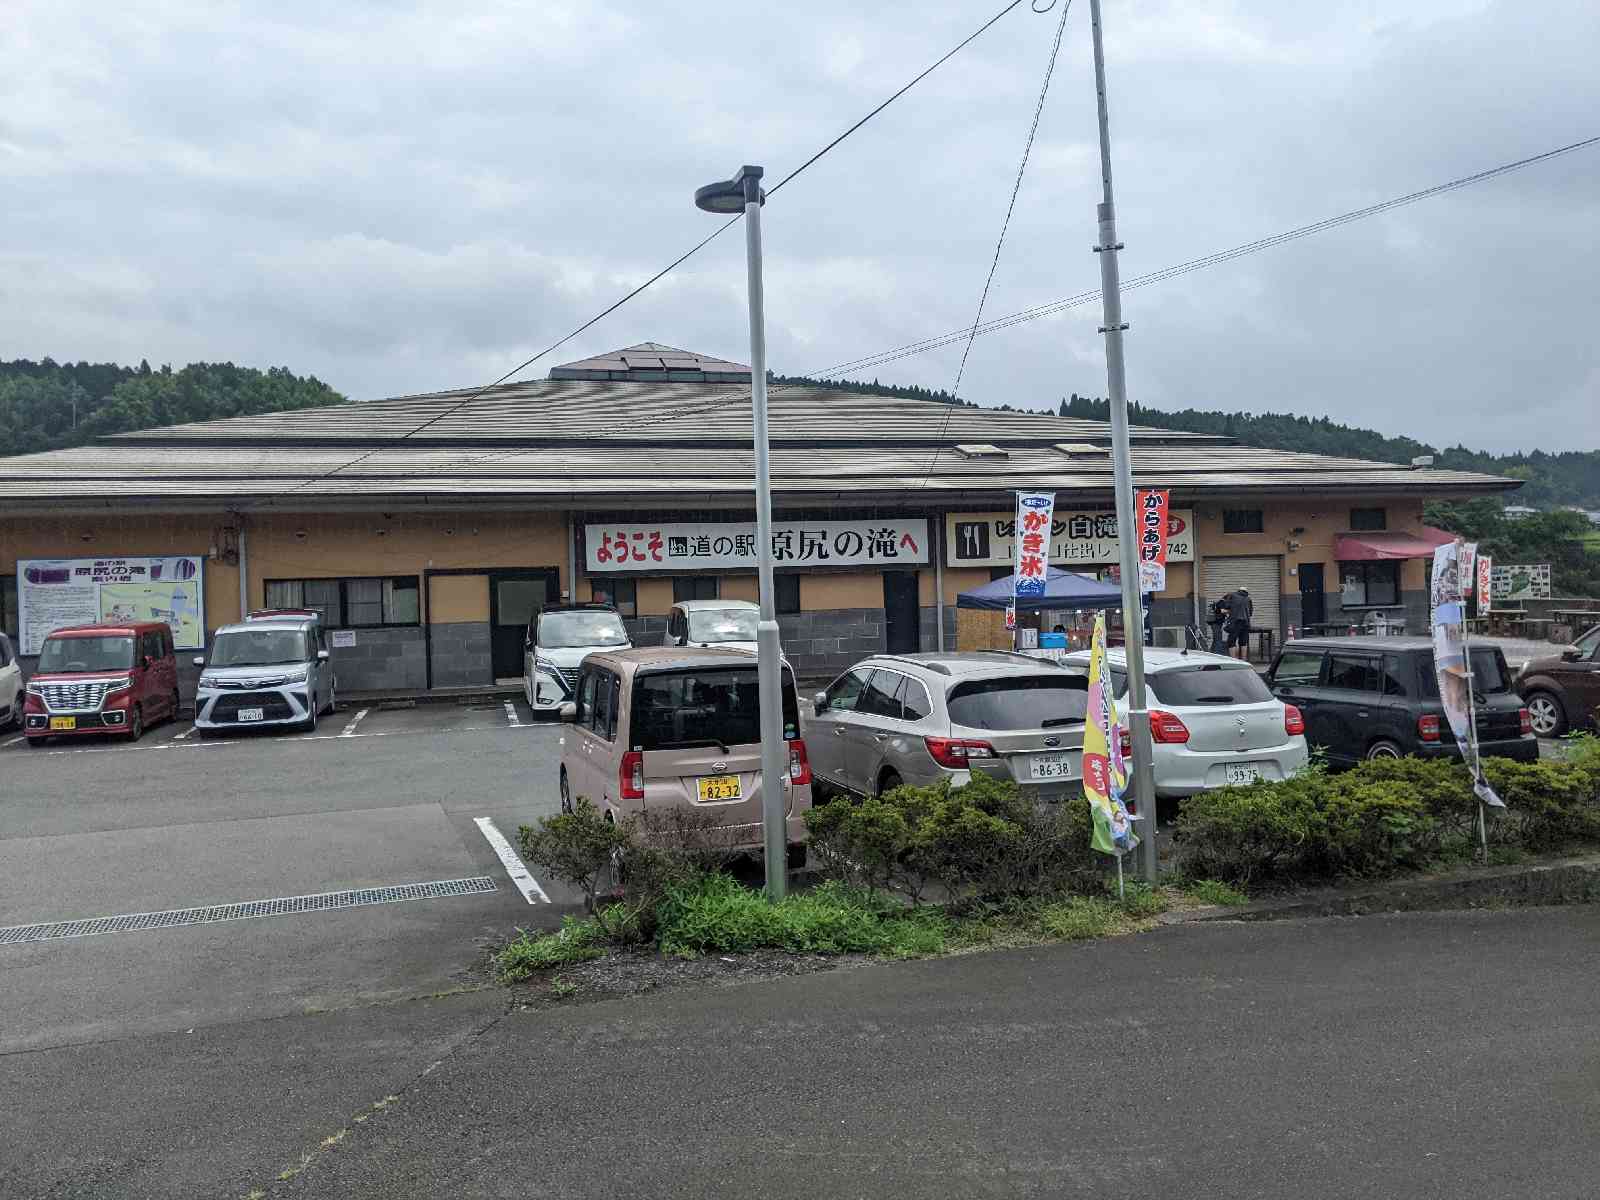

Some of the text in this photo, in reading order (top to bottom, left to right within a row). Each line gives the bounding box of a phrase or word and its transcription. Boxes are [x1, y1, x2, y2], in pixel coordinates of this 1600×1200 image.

[1143, 494, 1163, 561] からあげ
[597, 532, 663, 563] ようこそ
[690, 534, 757, 557] 道の駅
[1021, 511, 1048, 577] かき氷
[1040, 763, 1068, 777] 86-38
[1233, 769, 1258, 782] 99-75
[707, 785, 739, 799] 82-32
